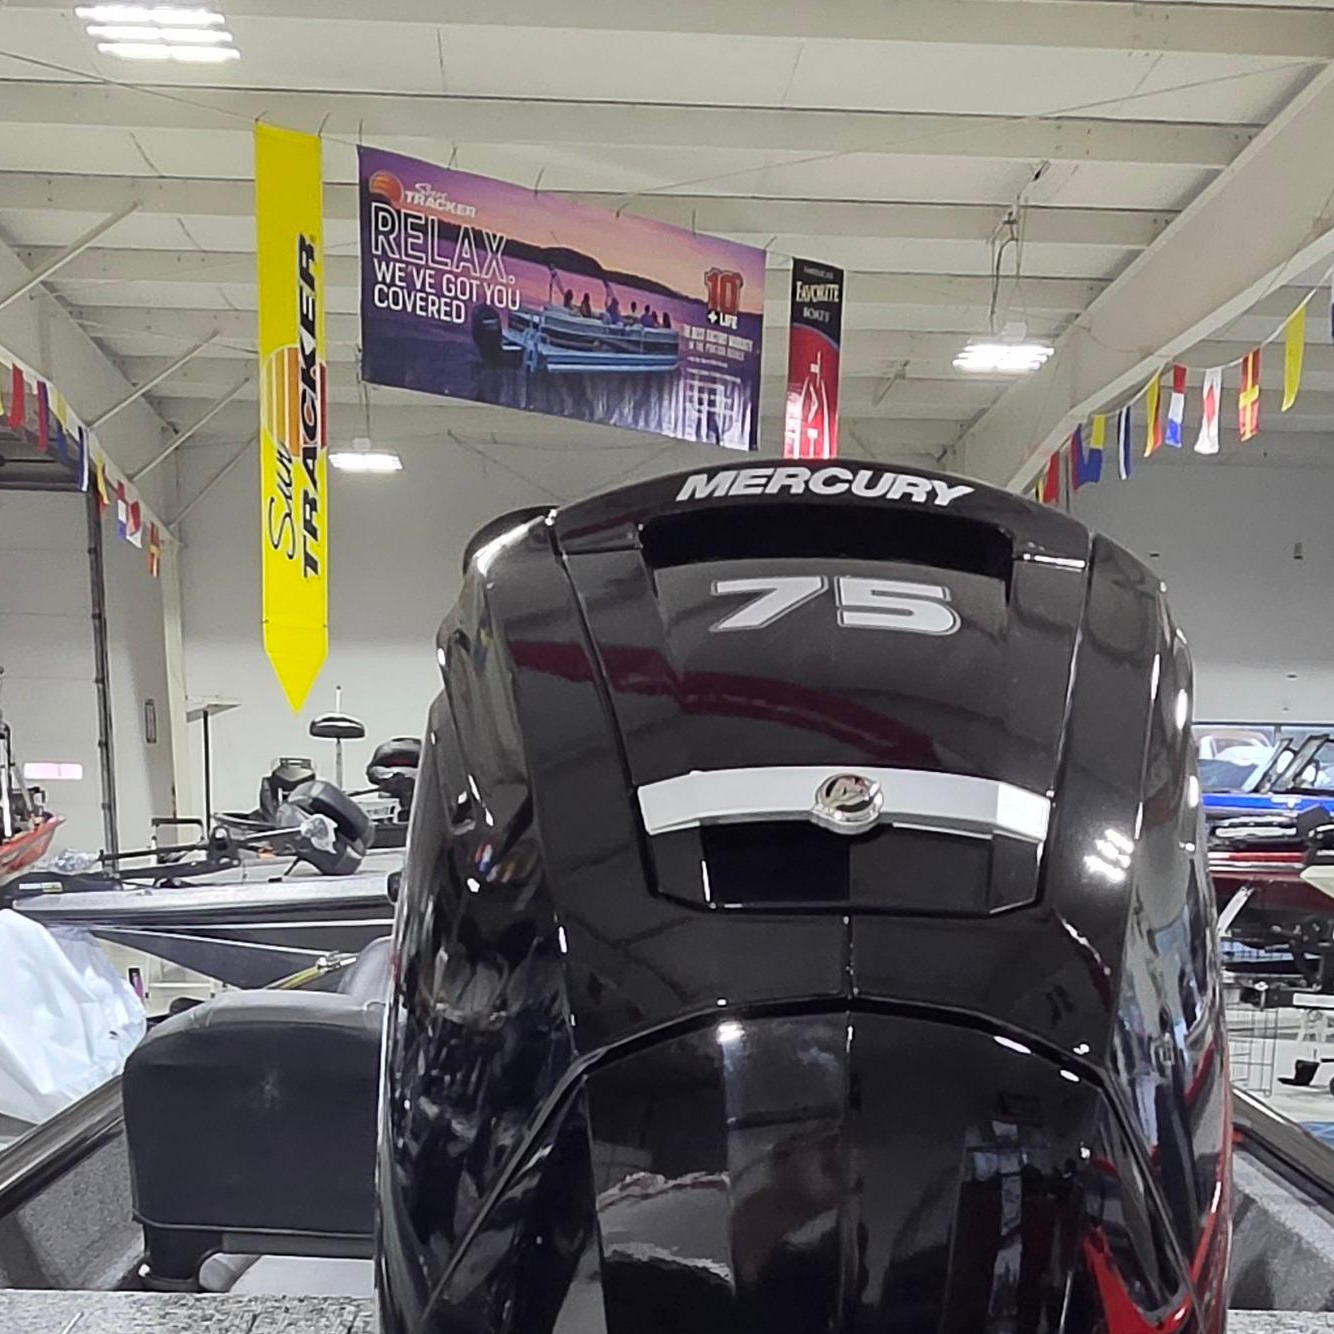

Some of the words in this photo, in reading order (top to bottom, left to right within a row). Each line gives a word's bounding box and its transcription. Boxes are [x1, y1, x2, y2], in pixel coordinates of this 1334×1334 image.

[405, 191, 476, 218] TRACKER
[371, 202, 516, 284] RELAX.
[373, 258, 436, 293] WE'VE
[443, 274, 480, 302] GOT
[483, 282, 520, 310] YOU
[374, 284, 466, 323] COVERED
[719, 312, 738, 329] LIFE
[298, 233, 319, 579] TRACKER
[269, 440, 295, 560] Sun
[675, 467, 975, 506] MERCURY
[709, 575, 961, 635] 75
